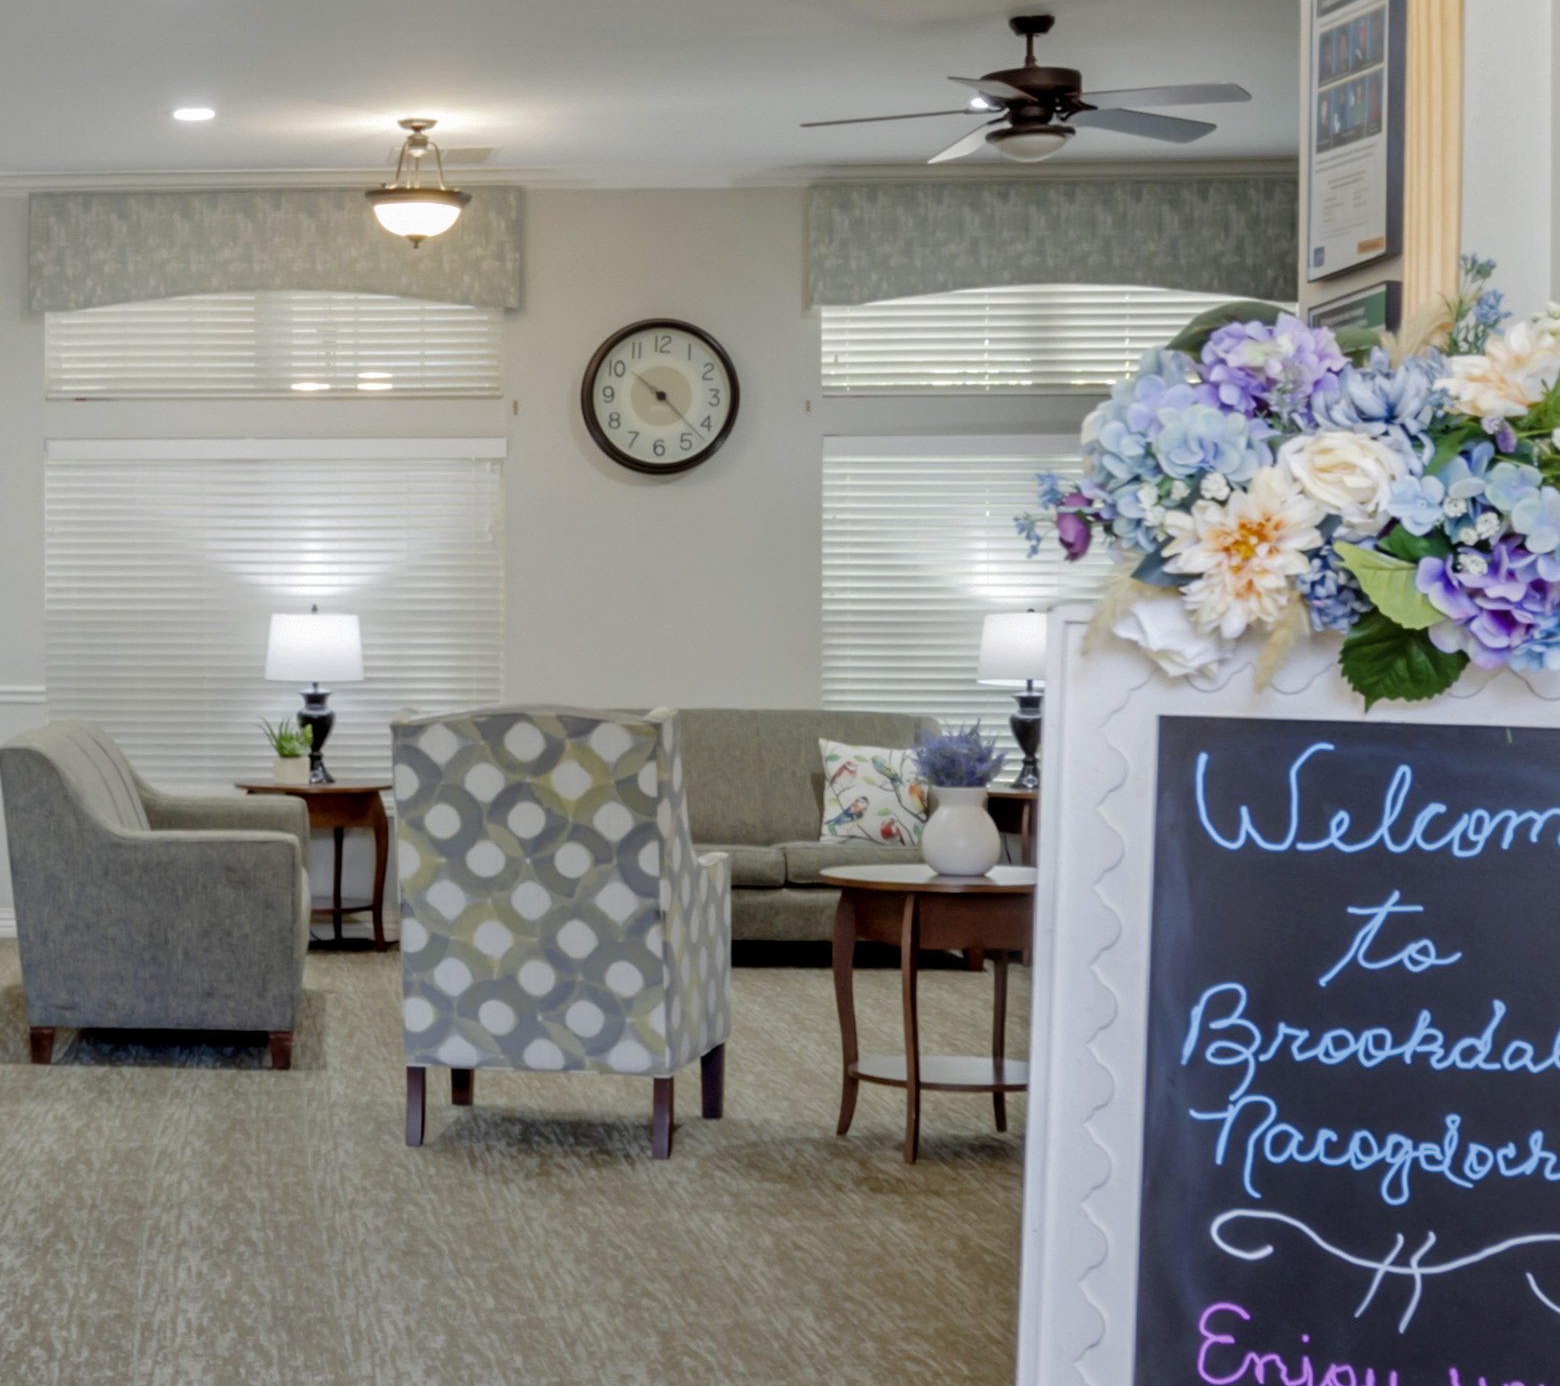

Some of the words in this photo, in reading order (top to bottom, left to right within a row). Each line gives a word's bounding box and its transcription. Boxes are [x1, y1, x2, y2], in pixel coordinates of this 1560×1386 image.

[631, 341, 642, 360] 11
[654, 335, 672, 354] 12
[608, 359, 626, 378] 10
[702, 362, 716, 381] 2
[602, 385, 615, 403] 9
[708, 388, 721, 407] 3
[608, 412, 621, 429] 8
[700, 414, 712, 432] 4
[627, 431, 640, 449] 7
[653, 439, 665, 457] 6
[679, 432, 693, 451] 5
[1318, 890, 1461, 987] to
